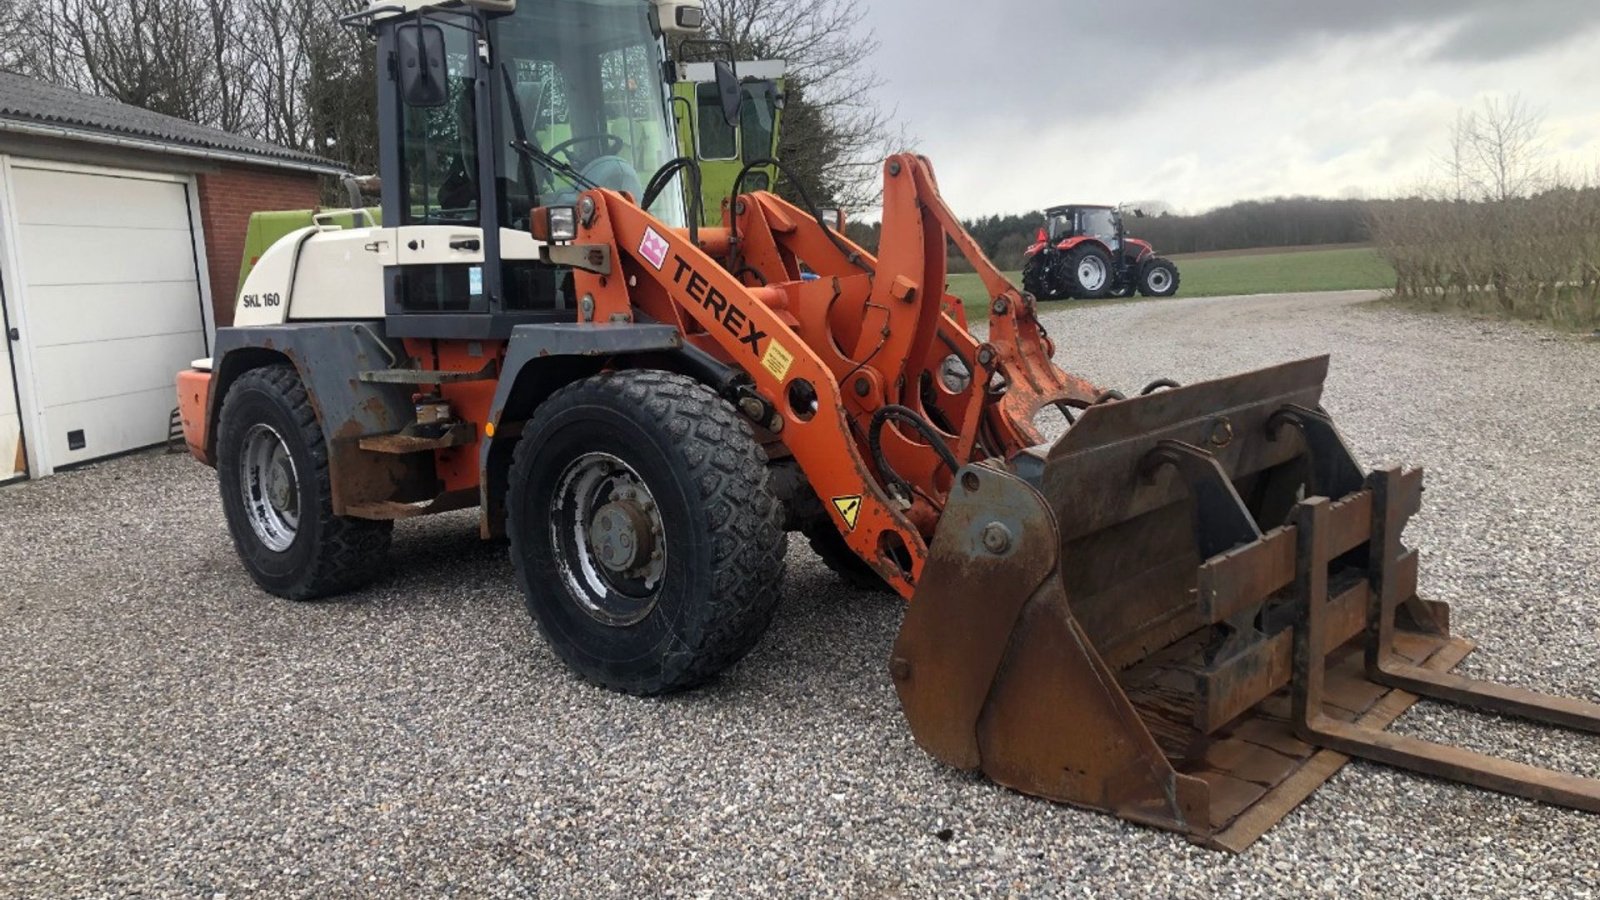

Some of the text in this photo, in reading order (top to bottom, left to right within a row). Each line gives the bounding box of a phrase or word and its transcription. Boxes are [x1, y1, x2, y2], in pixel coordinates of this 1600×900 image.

[243, 292, 280, 308] SKL 160
[673, 254, 768, 357] TEREX
